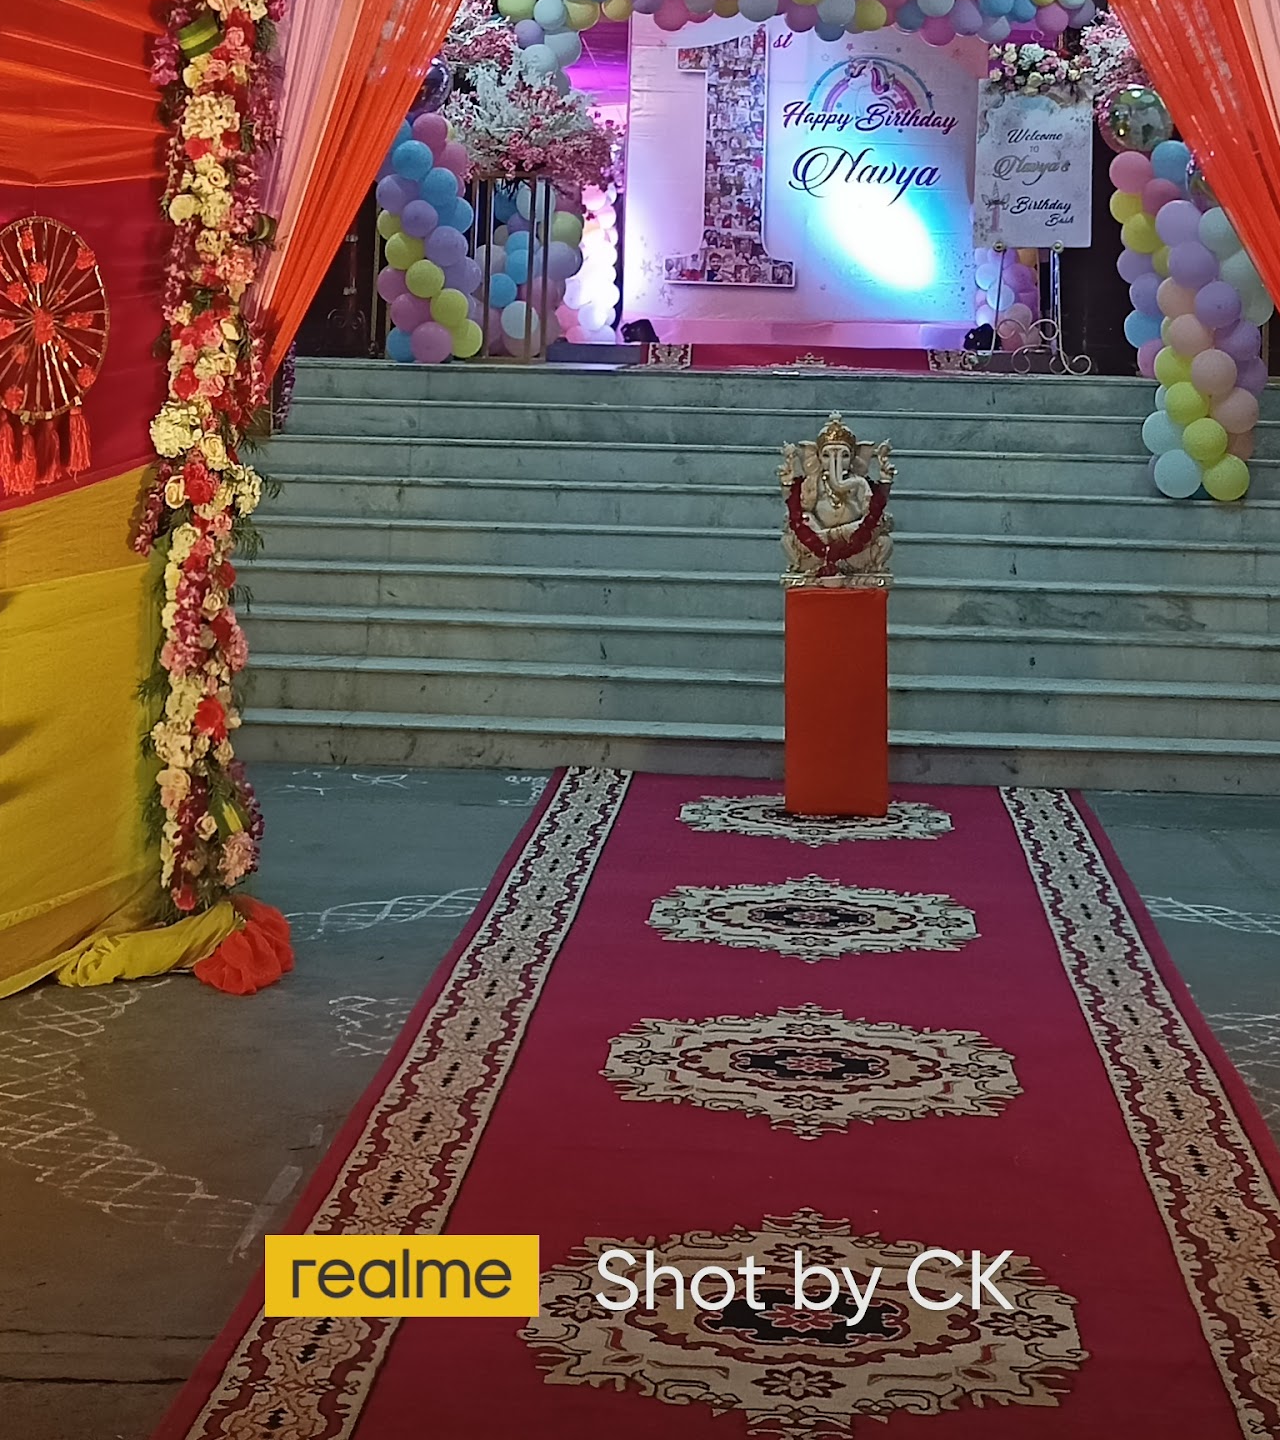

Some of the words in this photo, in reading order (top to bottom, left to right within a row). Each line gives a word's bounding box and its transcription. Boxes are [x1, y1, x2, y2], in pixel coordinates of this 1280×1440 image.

[773, 32, 793, 49] st
[783, 101, 854, 132] Happy
[855, 103, 959, 135] Birthday
[1007, 128, 1063, 144] Welcome
[788, 145, 941, 207] Navya
[1009, 196, 1072, 214] Birthday
